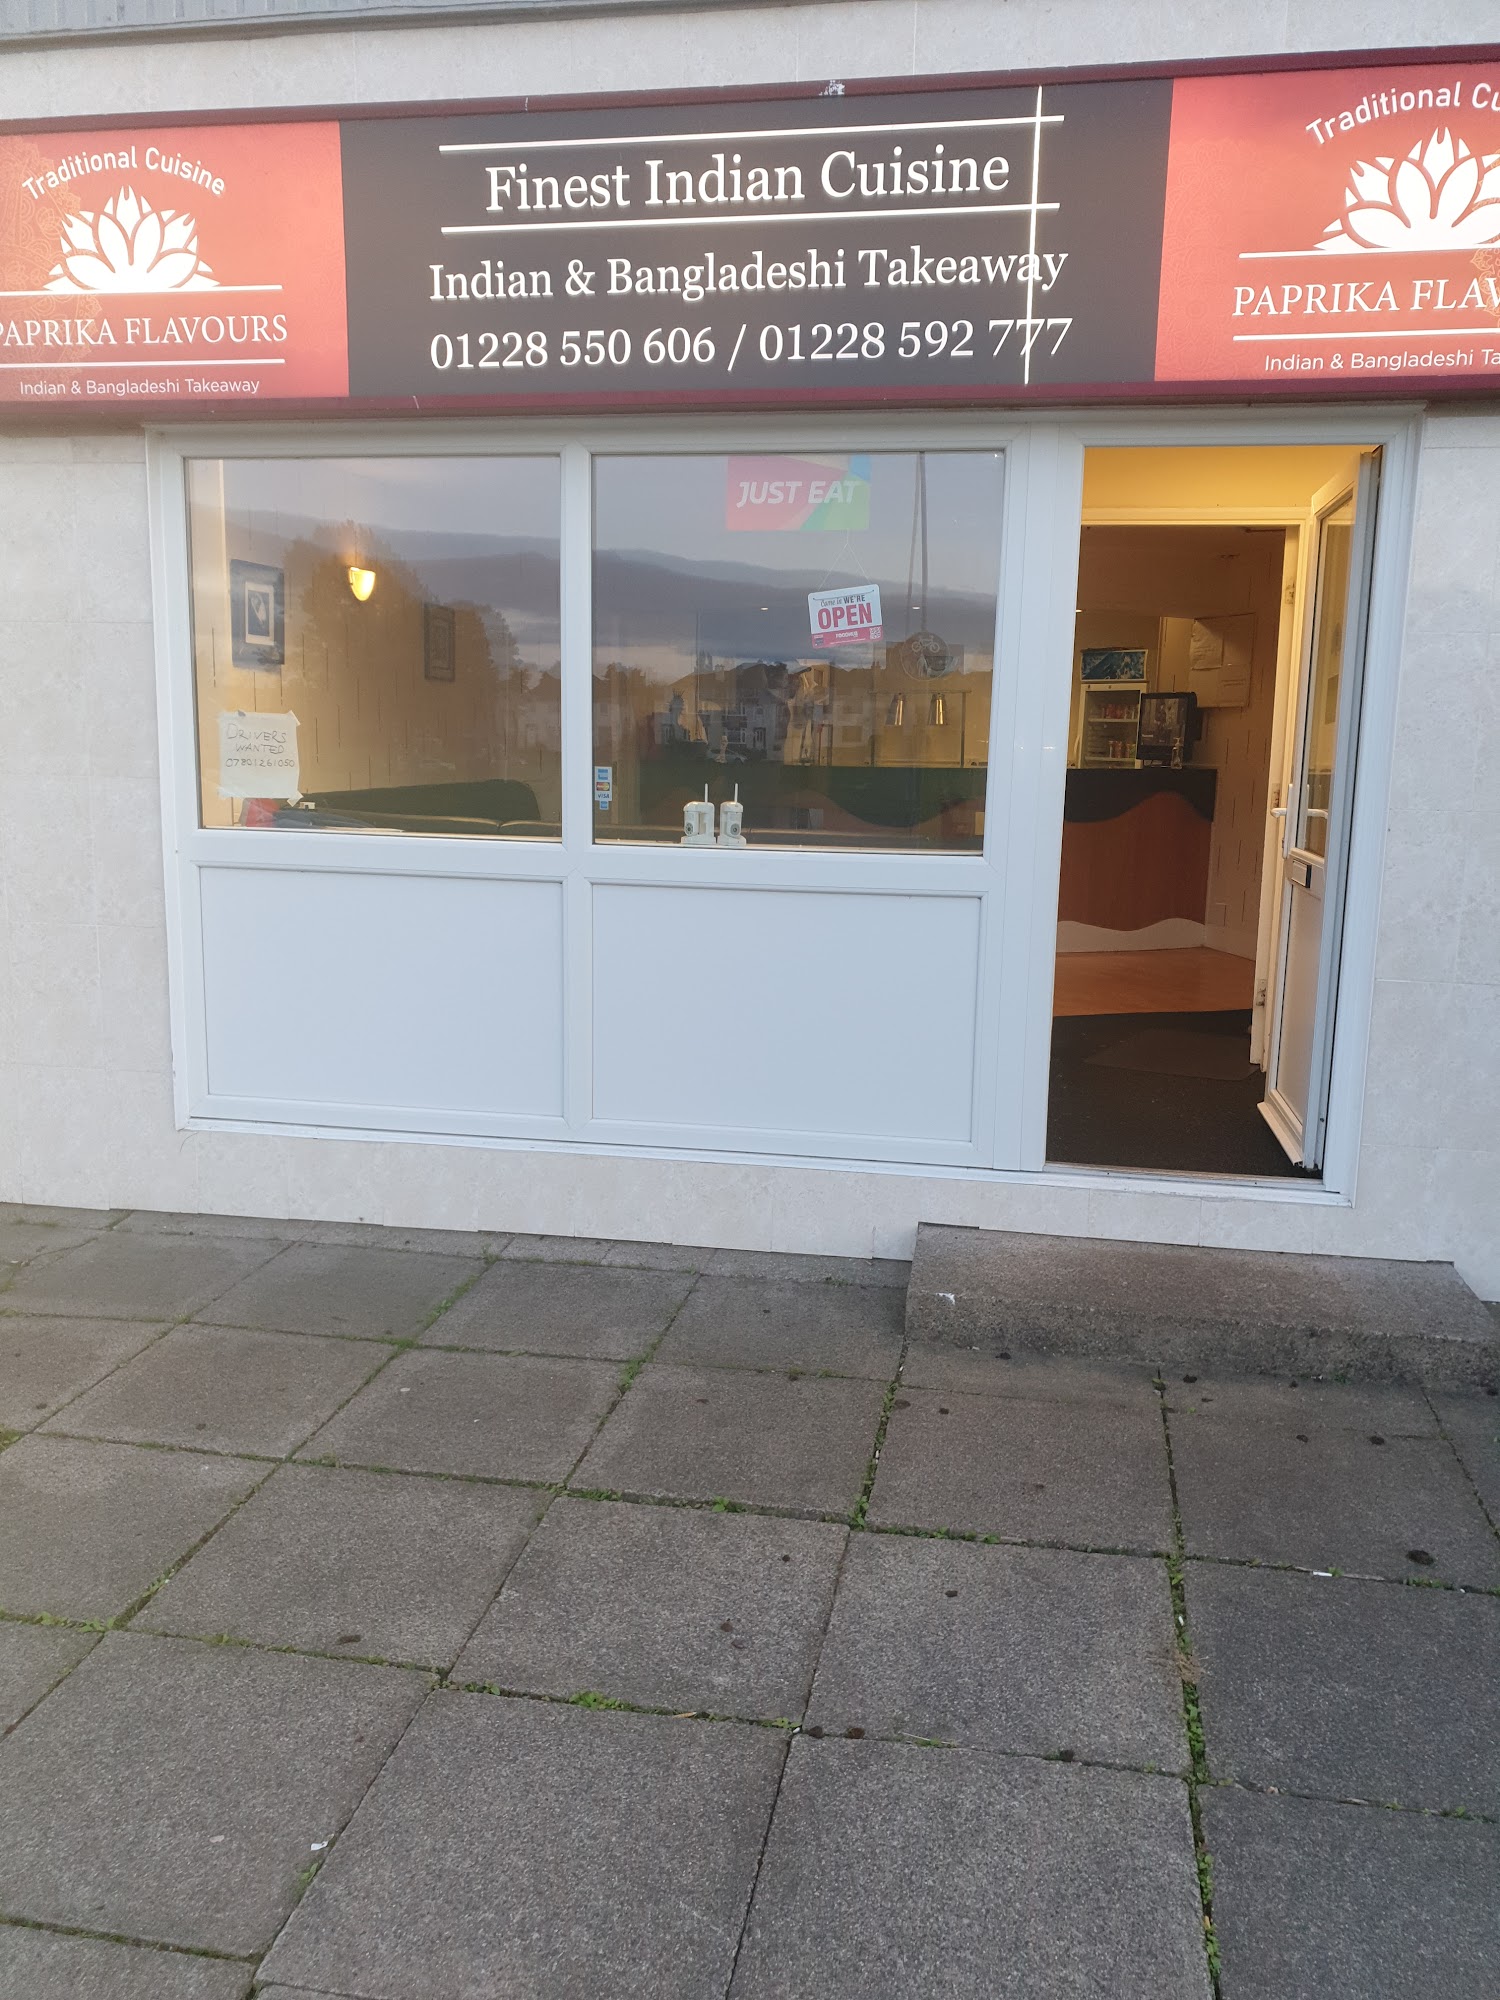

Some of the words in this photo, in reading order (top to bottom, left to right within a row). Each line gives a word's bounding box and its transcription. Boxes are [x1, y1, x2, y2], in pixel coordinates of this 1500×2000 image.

[1306, 82, 1461, 146] Traditional
[21, 145, 138, 201] Traditional
[145, 147, 226, 196] Cuisine
[485, 163, 631, 211] Finest
[644, 153, 806, 205] Indian
[820, 143, 1010, 198] Cuisine
[428, 259, 554, 300] Indian
[564, 259, 596, 296] &
[606, 248, 847, 302] Bangladeshi
[857, 245, 1069, 291] Takeaway
[1232, 281, 1400, 316] PAPRIKA
[0, 318, 117, 347] APRIKA
[124, 314, 288, 344] FLAVOURS
[430, 331, 549, 369] 01228
[559, 328, 632, 366] 550
[643, 326, 716, 364] 606
[727, 323, 748, 372] /
[759, 322, 886, 361] 01228
[898, 319, 974, 358] 592
[988, 317, 1073, 356] 777
[1264, 354, 1324, 371] Indian
[1330, 353, 1344, 370] &
[1351, 348, 1474, 371] Bangladeshi
[20, 380, 66, 395] Indian
[71, 380, 82, 395] &
[86, 378, 180, 397] Bangladeshi
[185, 377, 260, 395] Takeaway
[736, 480, 802, 508] JUST
[808, 480, 860, 504] EAT
[843, 594, 866, 605] WE'RE
[818, 602, 873, 630] OPEN
[226, 723, 287, 743] DRIVERS
[235, 743, 285, 755] WANTED
